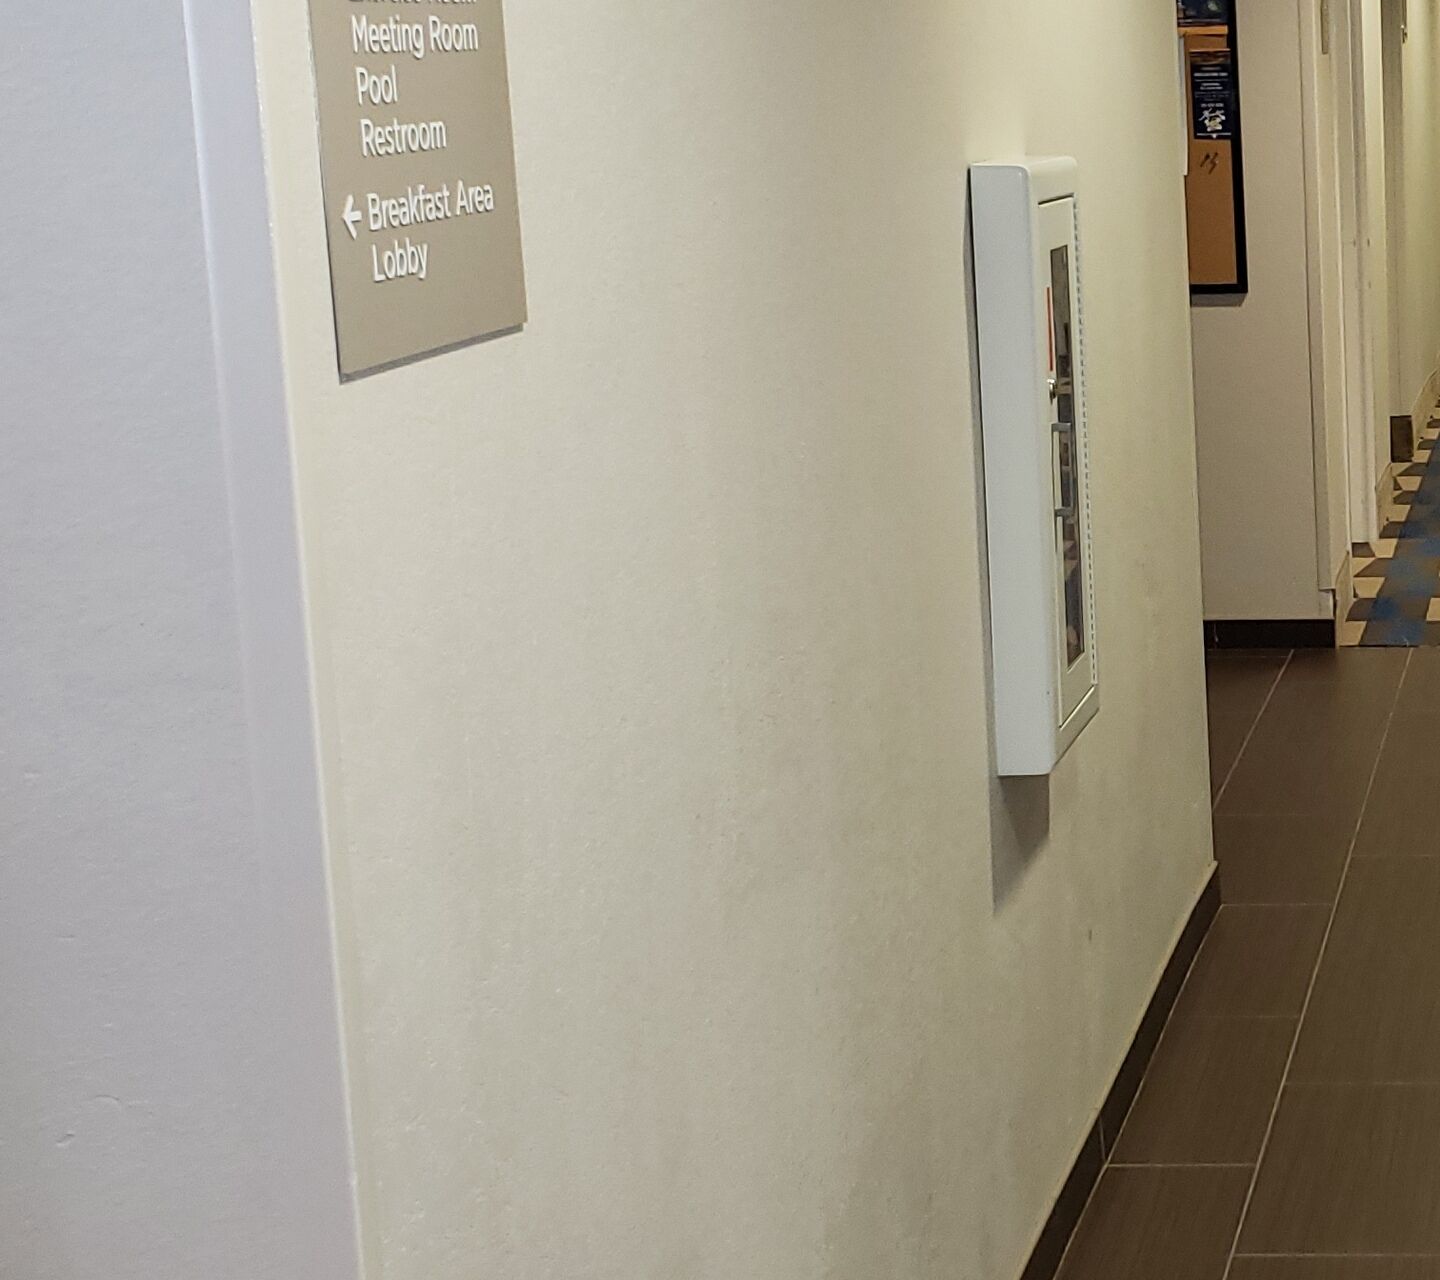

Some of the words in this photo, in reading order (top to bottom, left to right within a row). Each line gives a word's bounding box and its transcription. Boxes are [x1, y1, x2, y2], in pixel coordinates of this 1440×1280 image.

[351, 14, 424, 60] Meeting
[428, 15, 479, 52] Room
[355, 64, 398, 105] Pool
[360, 117, 447, 157] Restroom
[366, 183, 451, 232] Breakfast
[455, 179, 495, 217] Area
[371, 237, 428, 283] Lobby
